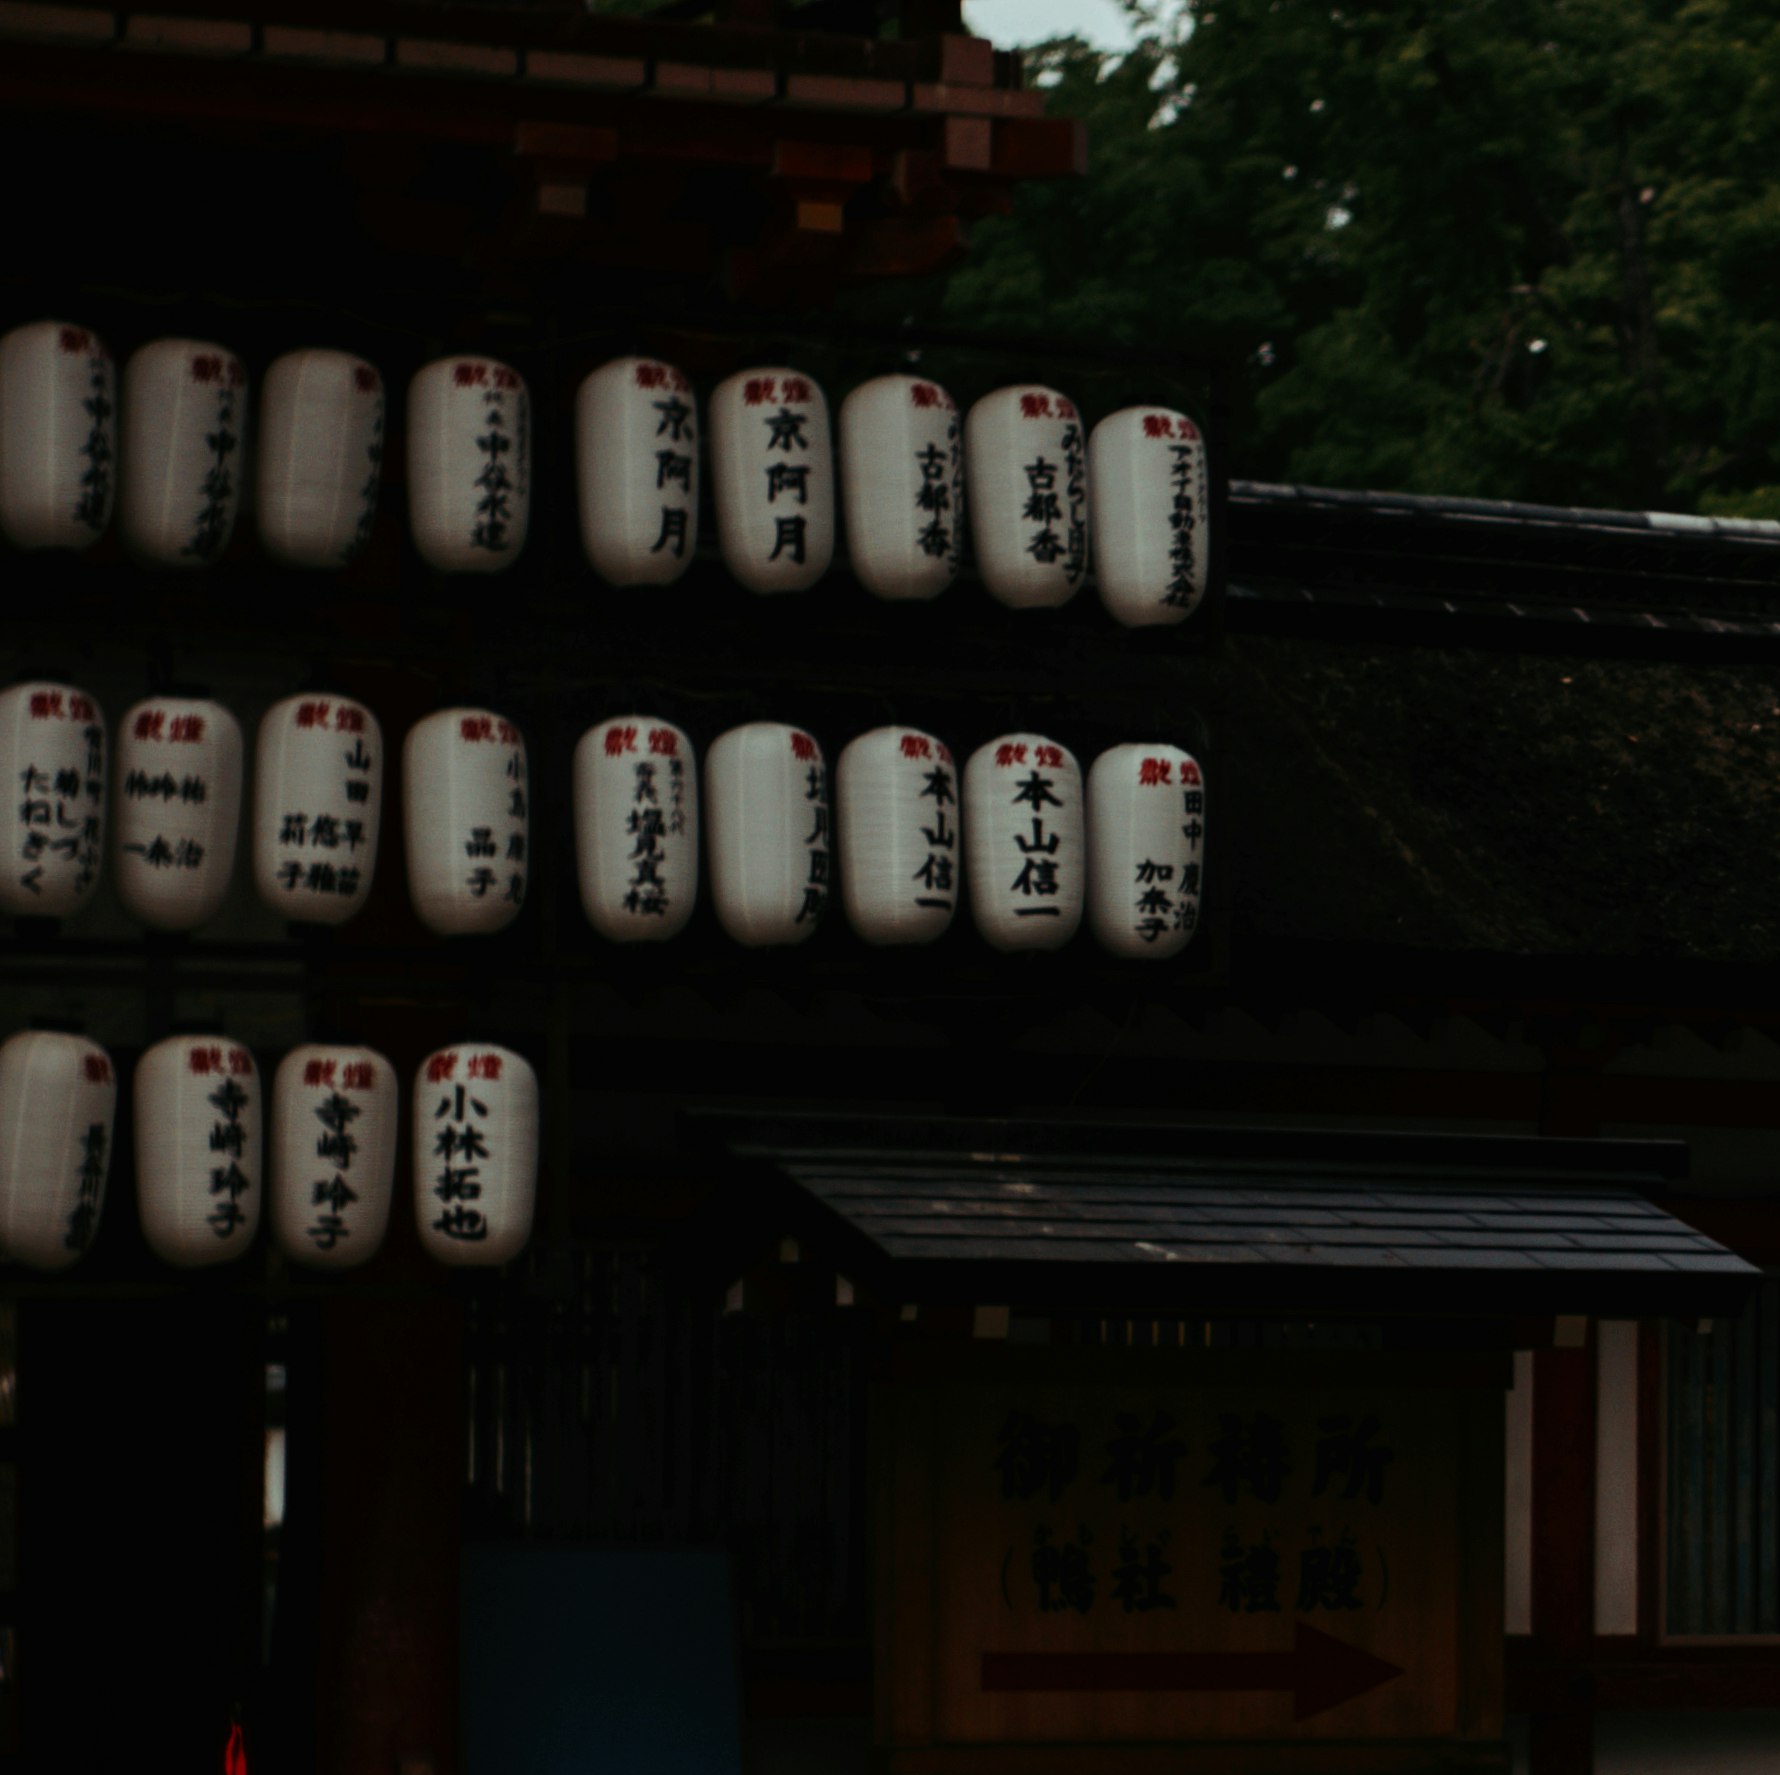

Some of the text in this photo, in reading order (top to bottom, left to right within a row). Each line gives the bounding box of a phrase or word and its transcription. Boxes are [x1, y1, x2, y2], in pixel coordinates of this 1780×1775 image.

[652, 397, 693, 556] 京阿月
[765, 407, 809, 564] 京阿月
[915, 442, 950, 557] 古都香
[1022, 457, 1065, 563] 古都香
[1159, 444, 1195, 609] アオイ自動車株式会社
[914, 766, 953, 911] 本山信一
[1012, 770, 1062, 917] 本山信一
[433, 1085, 489, 1240] 小林拓也
